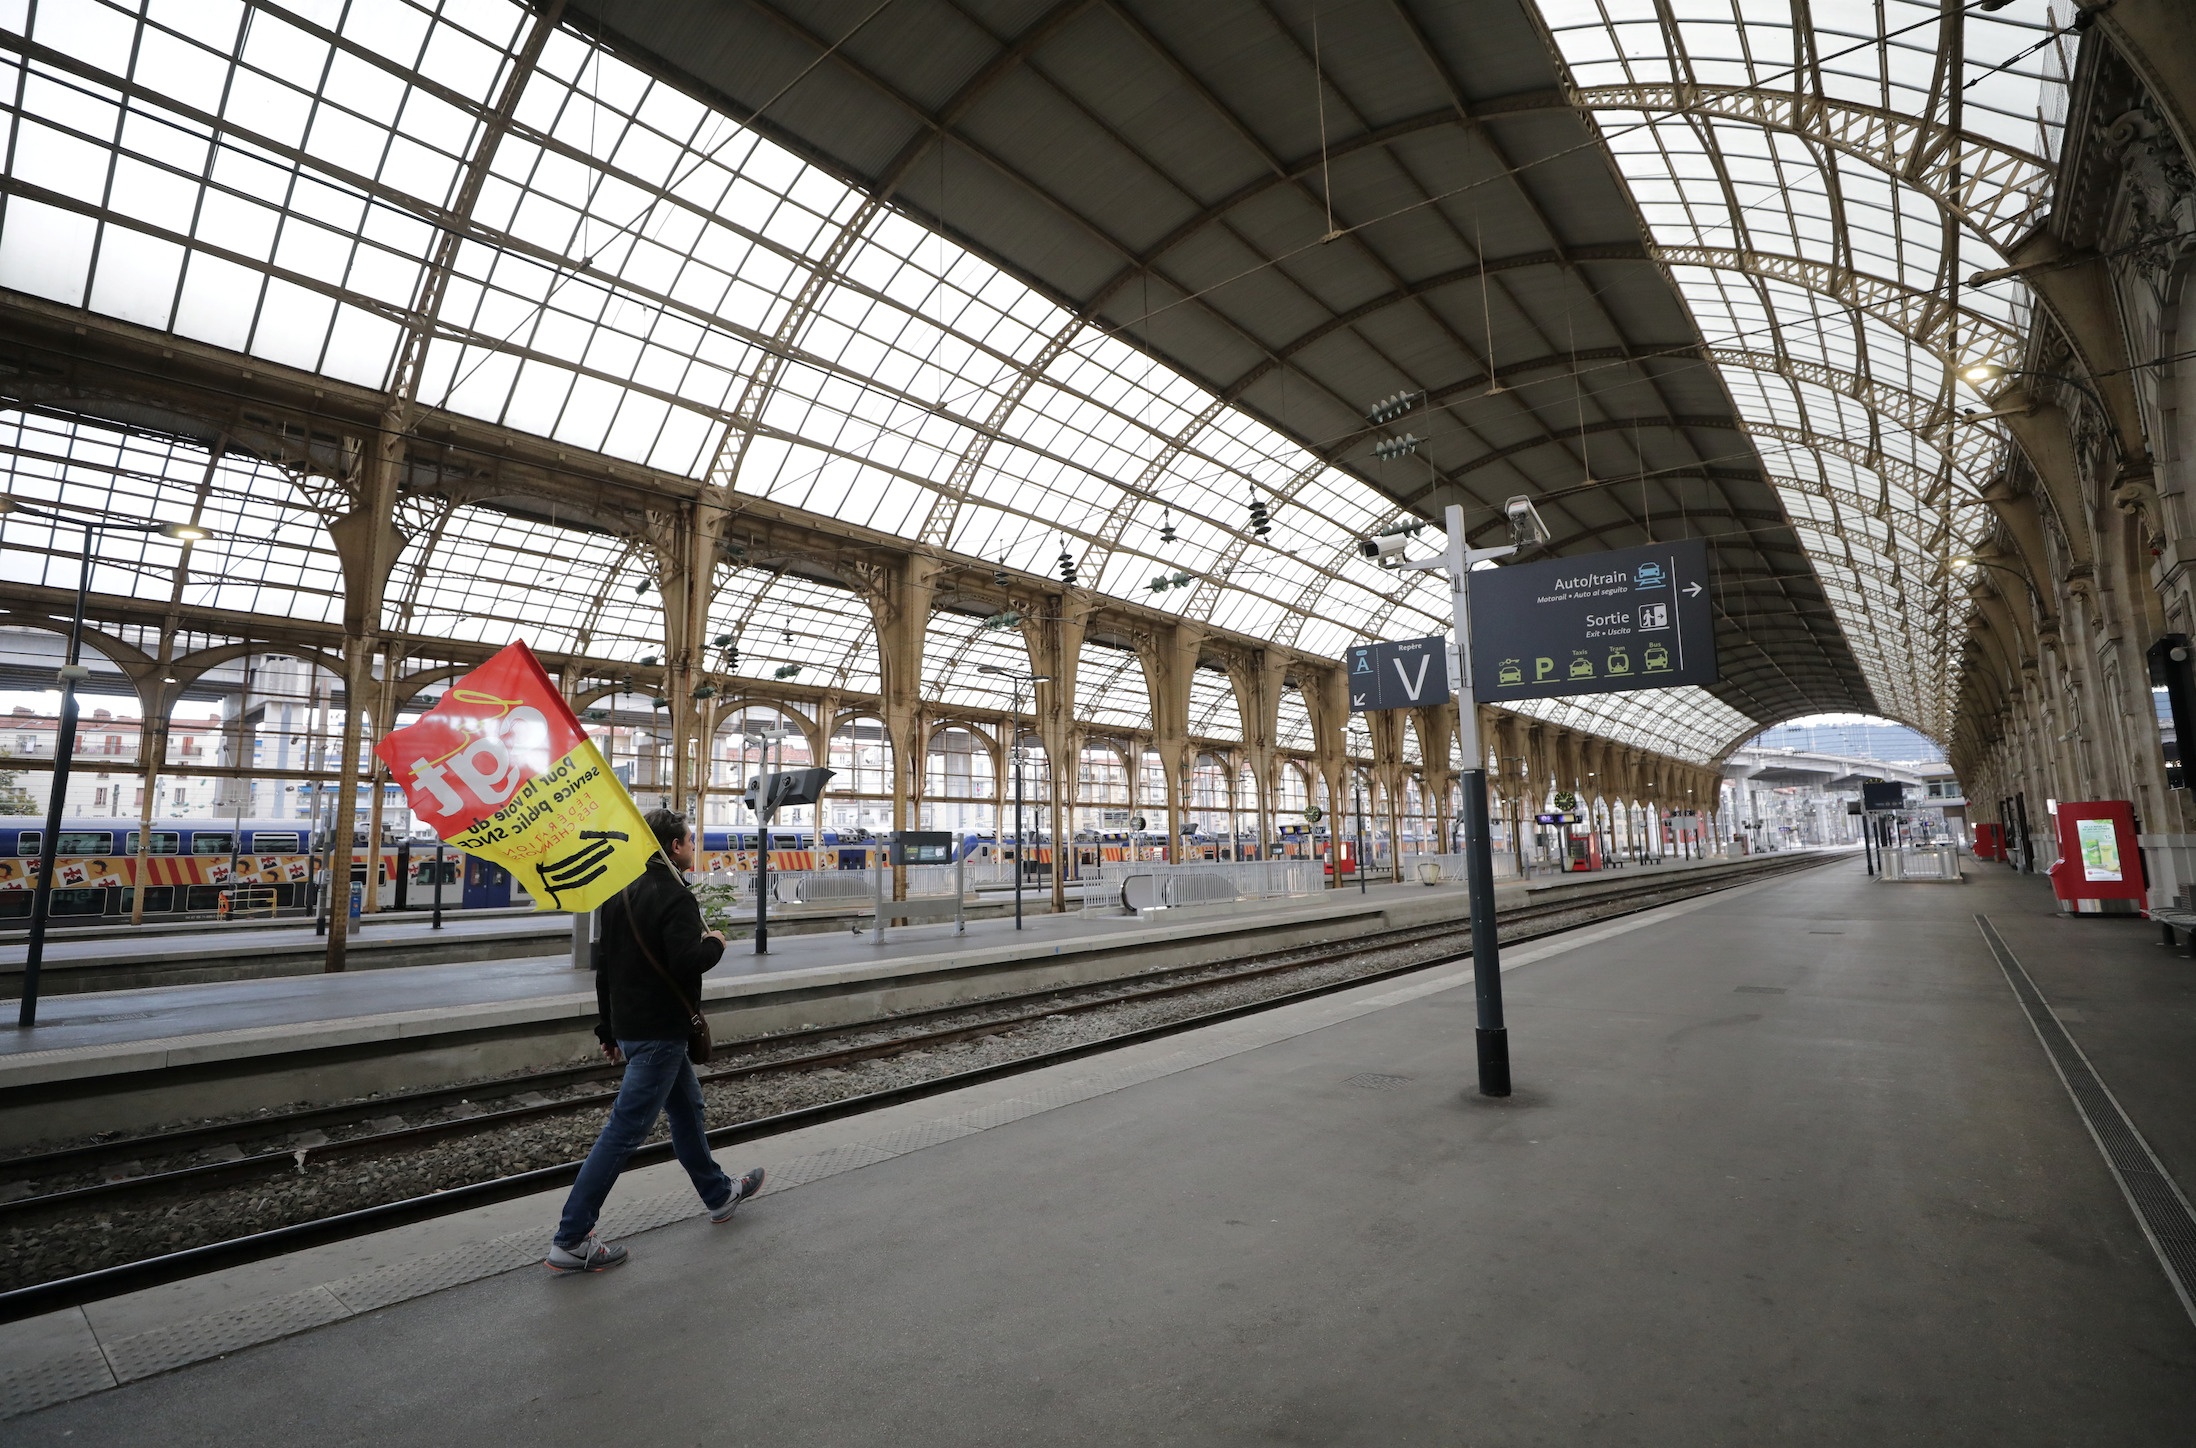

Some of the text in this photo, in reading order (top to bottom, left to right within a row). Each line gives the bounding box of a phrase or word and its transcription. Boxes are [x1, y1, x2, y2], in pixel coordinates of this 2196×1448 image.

[1554, 570, 1627, 591] Auto/train
[1536, 586, 1628, 604] Motorail Auto al seguito
[1586, 611, 1630, 627] Sortie
[1585, 627, 1631, 639] Exit Uscita
[1398, 643, 1422, 652] Repère
[1356, 656, 1370, 672] A
[1535, 657, 1555, 681] P
[1392, 653, 1431, 702] V
